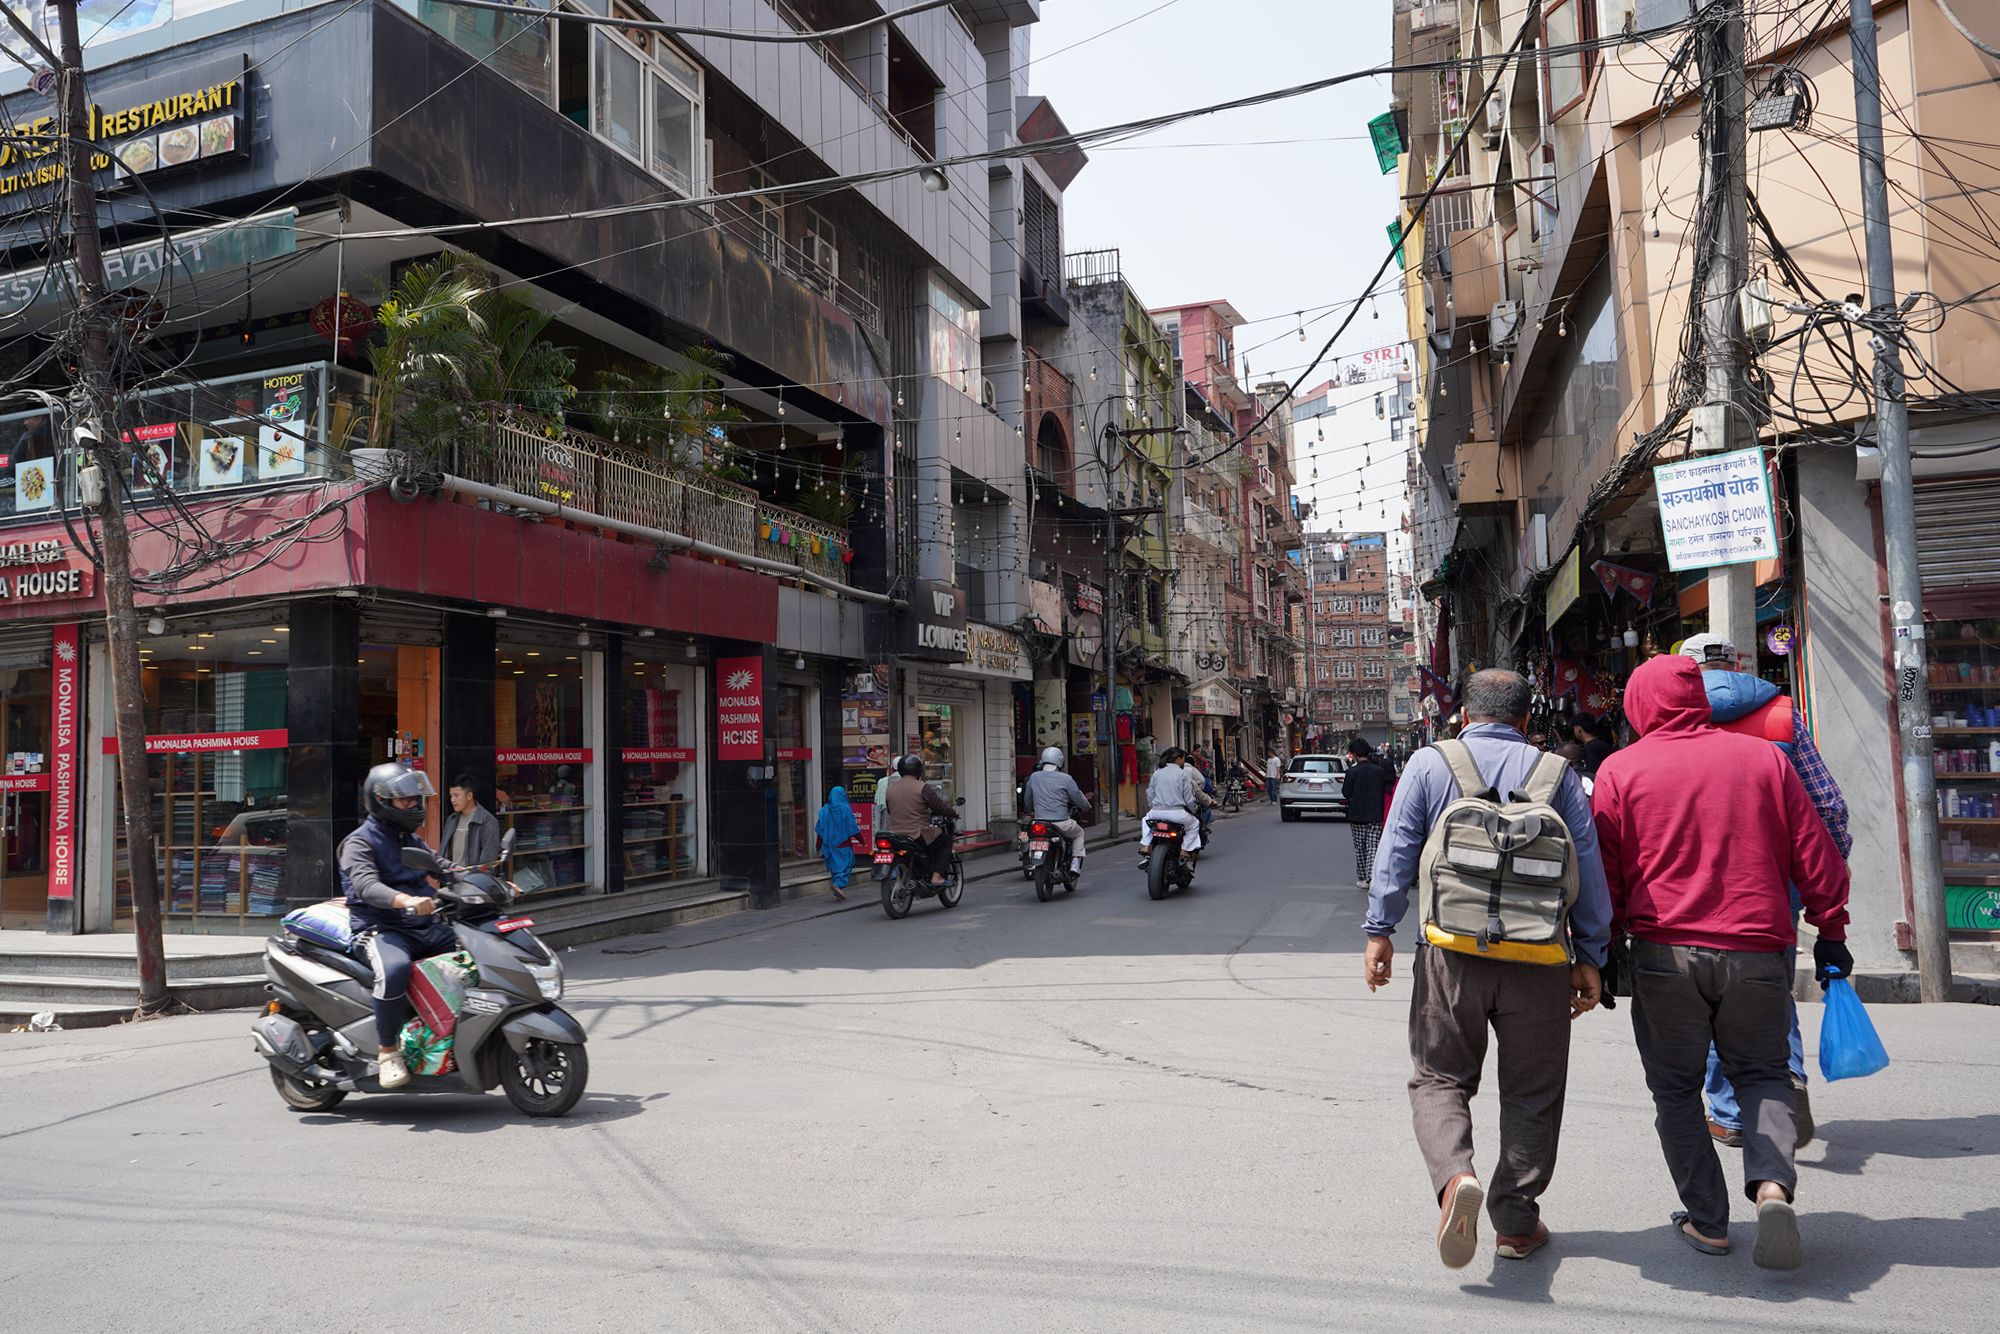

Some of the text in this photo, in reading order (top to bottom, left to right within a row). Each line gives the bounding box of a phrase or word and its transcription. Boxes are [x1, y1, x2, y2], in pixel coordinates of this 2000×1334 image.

[101, 81, 236, 139] RESTAURANT
[1363, 346, 1400, 365] SIRI
[264, 373, 304, 389] HOTPOT
[542, 446, 574, 468] FOODS
[1662, 475, 1759, 509] सञ्चयकोष चोक
[1666, 505, 1767, 533] SANCHAYKOSH CHOWK
[16, 569, 79, 597] HOUSE
[933, 590, 955, 617] VIP
[918, 623, 967, 652] LOUNGE
[1773, 632, 1791, 641] GO
[720, 696, 760, 707] MONALISA
[720, 713, 760, 724] PASHMINA
[153, 735, 259, 749] MONALISA PASHMINA HOUSE
[722, 730, 758, 745] HOUSE
[506, 752, 582, 761] MONALISA PASHMINA HOUSE
[15, 779, 37, 788] HOUSE
[55, 668, 72, 885] MONALISA PASHMINA HOUSE
